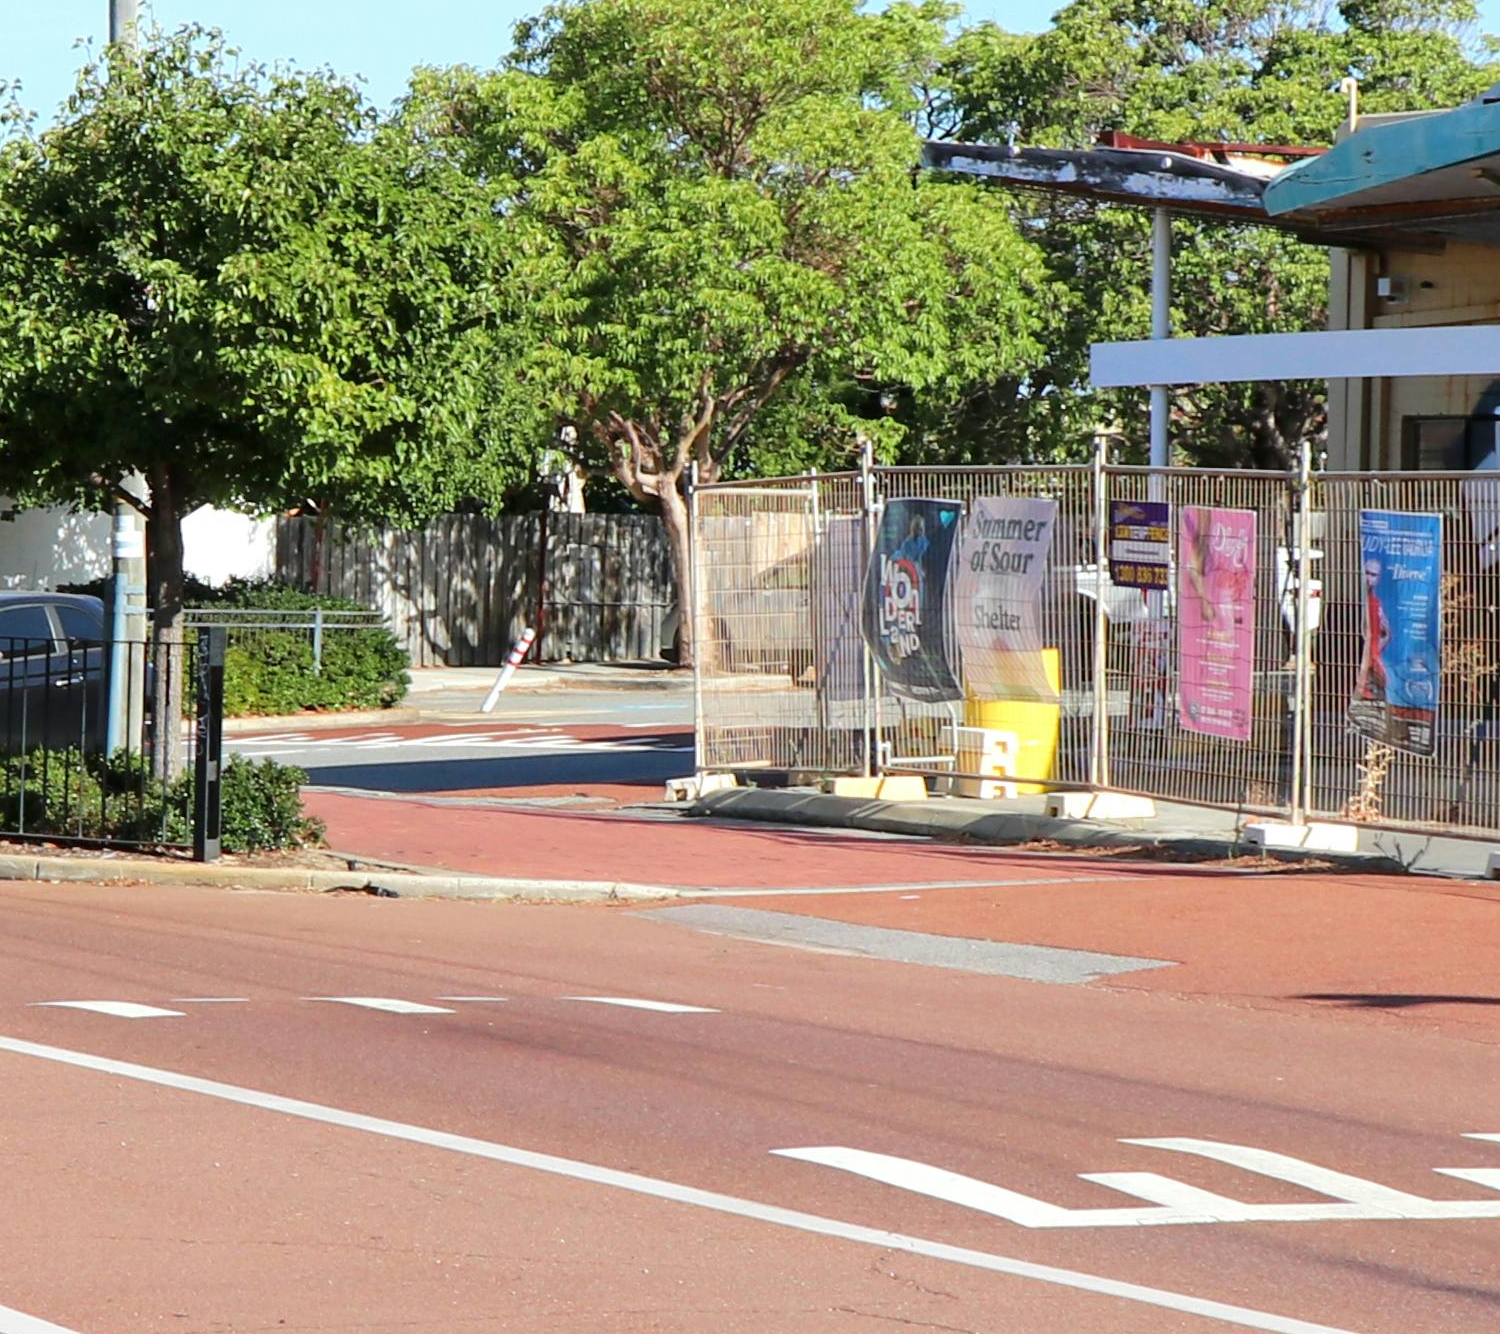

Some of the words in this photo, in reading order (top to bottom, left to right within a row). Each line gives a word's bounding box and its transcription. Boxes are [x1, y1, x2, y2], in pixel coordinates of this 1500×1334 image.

[973, 510, 1048, 542] Summer
[970, 542, 989, 573] of
[990, 543, 1034, 575] Sour
[974, 604, 1022, 631] Shelter
